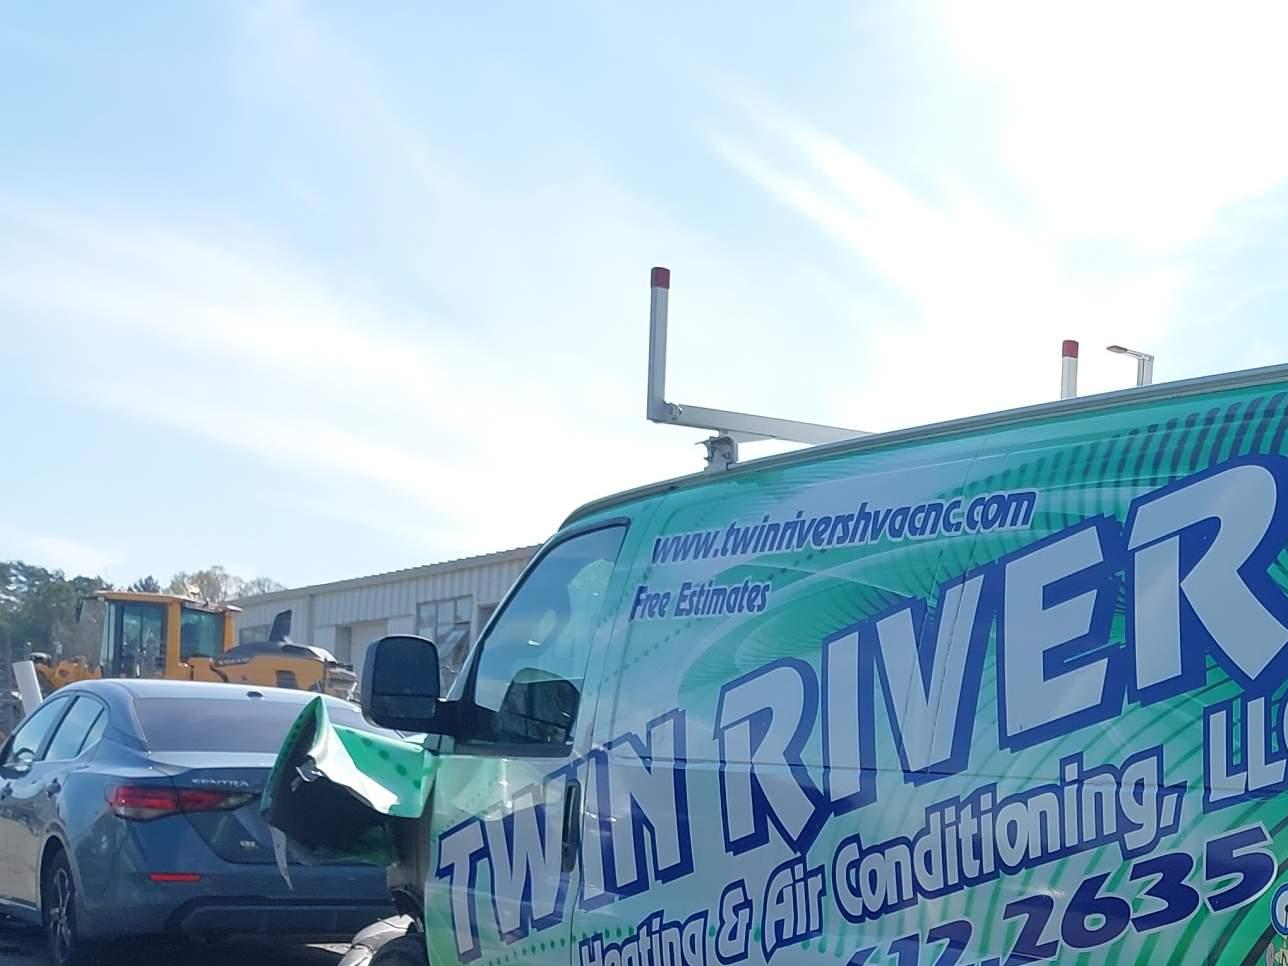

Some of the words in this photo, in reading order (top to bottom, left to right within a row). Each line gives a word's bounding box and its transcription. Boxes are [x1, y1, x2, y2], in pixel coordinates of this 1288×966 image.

[652, 490, 1037, 564] www.twinrivershvacnc.com
[629, 585, 668, 621] Free
[674, 578, 770, 618] Estimates
[436, 708, 694, 961] TWIN
[716, 884, 751, 966] &
[762, 857, 825, 962] Air
[834, 753, 1184, 921] Conditioning,
